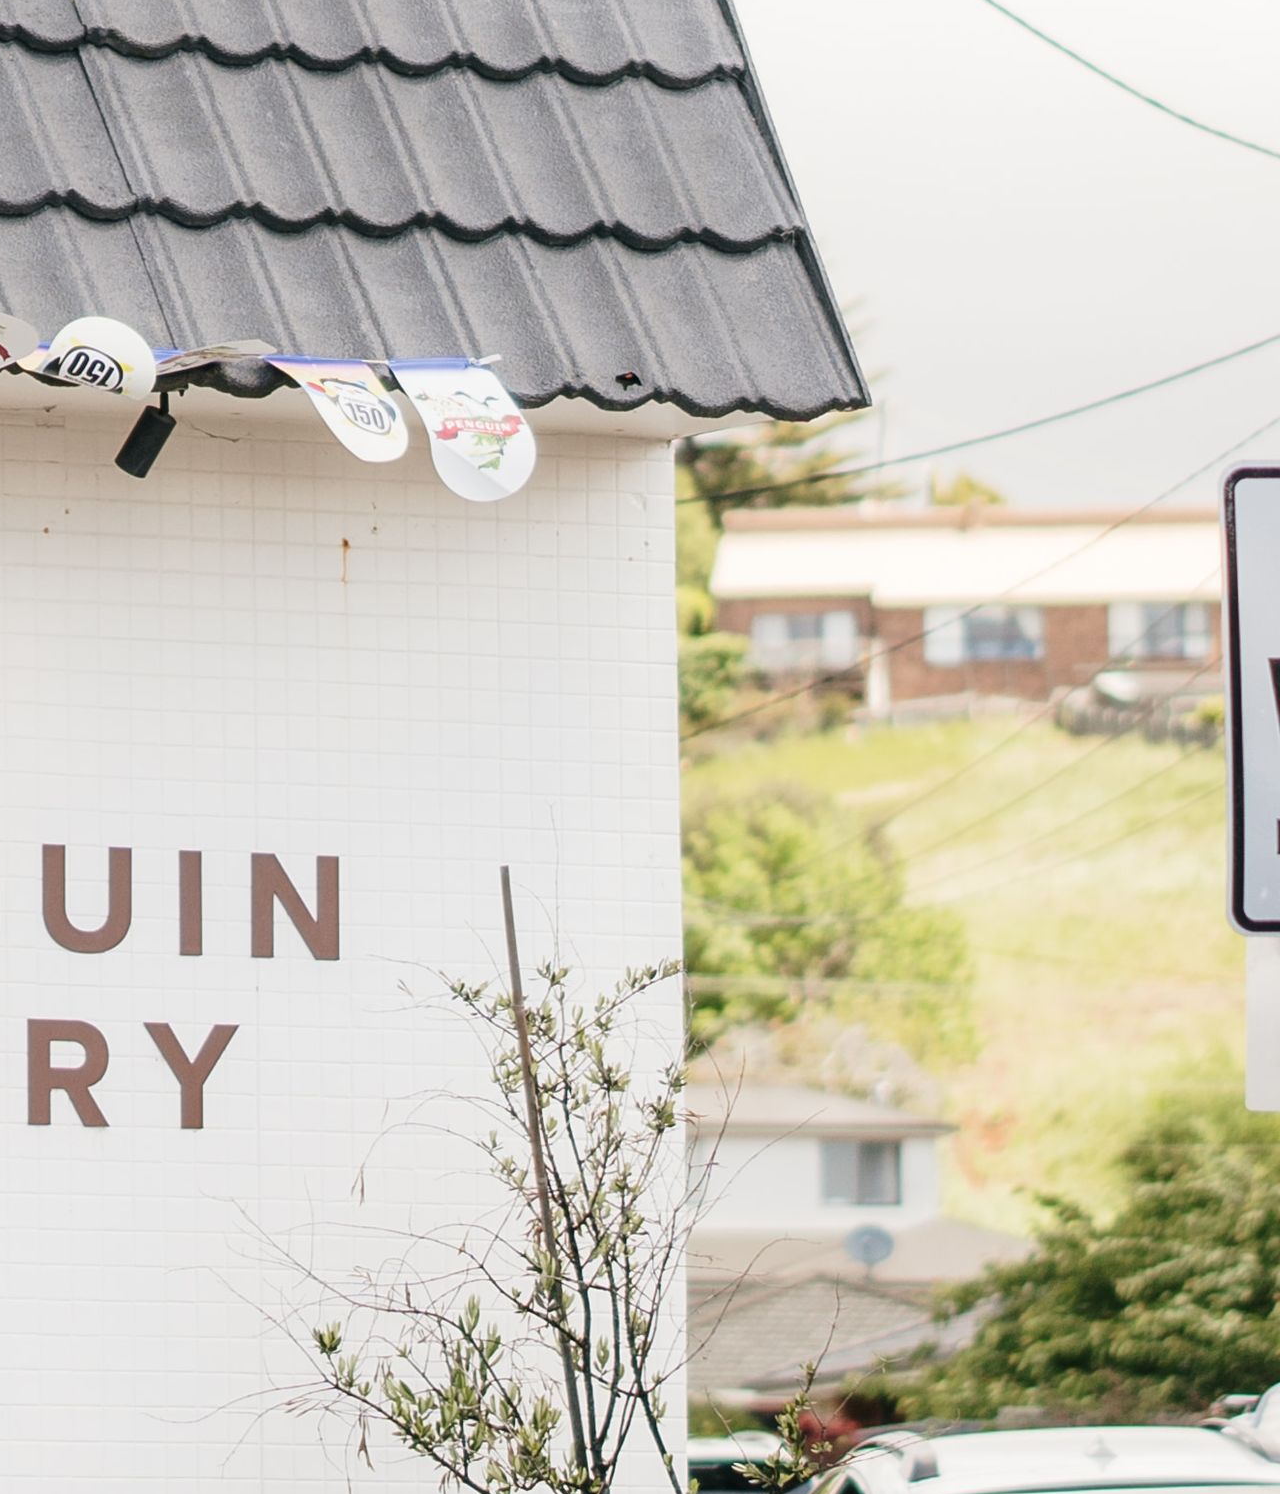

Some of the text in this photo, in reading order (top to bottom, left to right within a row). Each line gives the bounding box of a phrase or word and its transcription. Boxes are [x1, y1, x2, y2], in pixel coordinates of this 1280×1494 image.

[66, 352, 114, 387] 150
[345, 403, 385, 431] 150
[445, 418, 513, 434] PENGUIN
